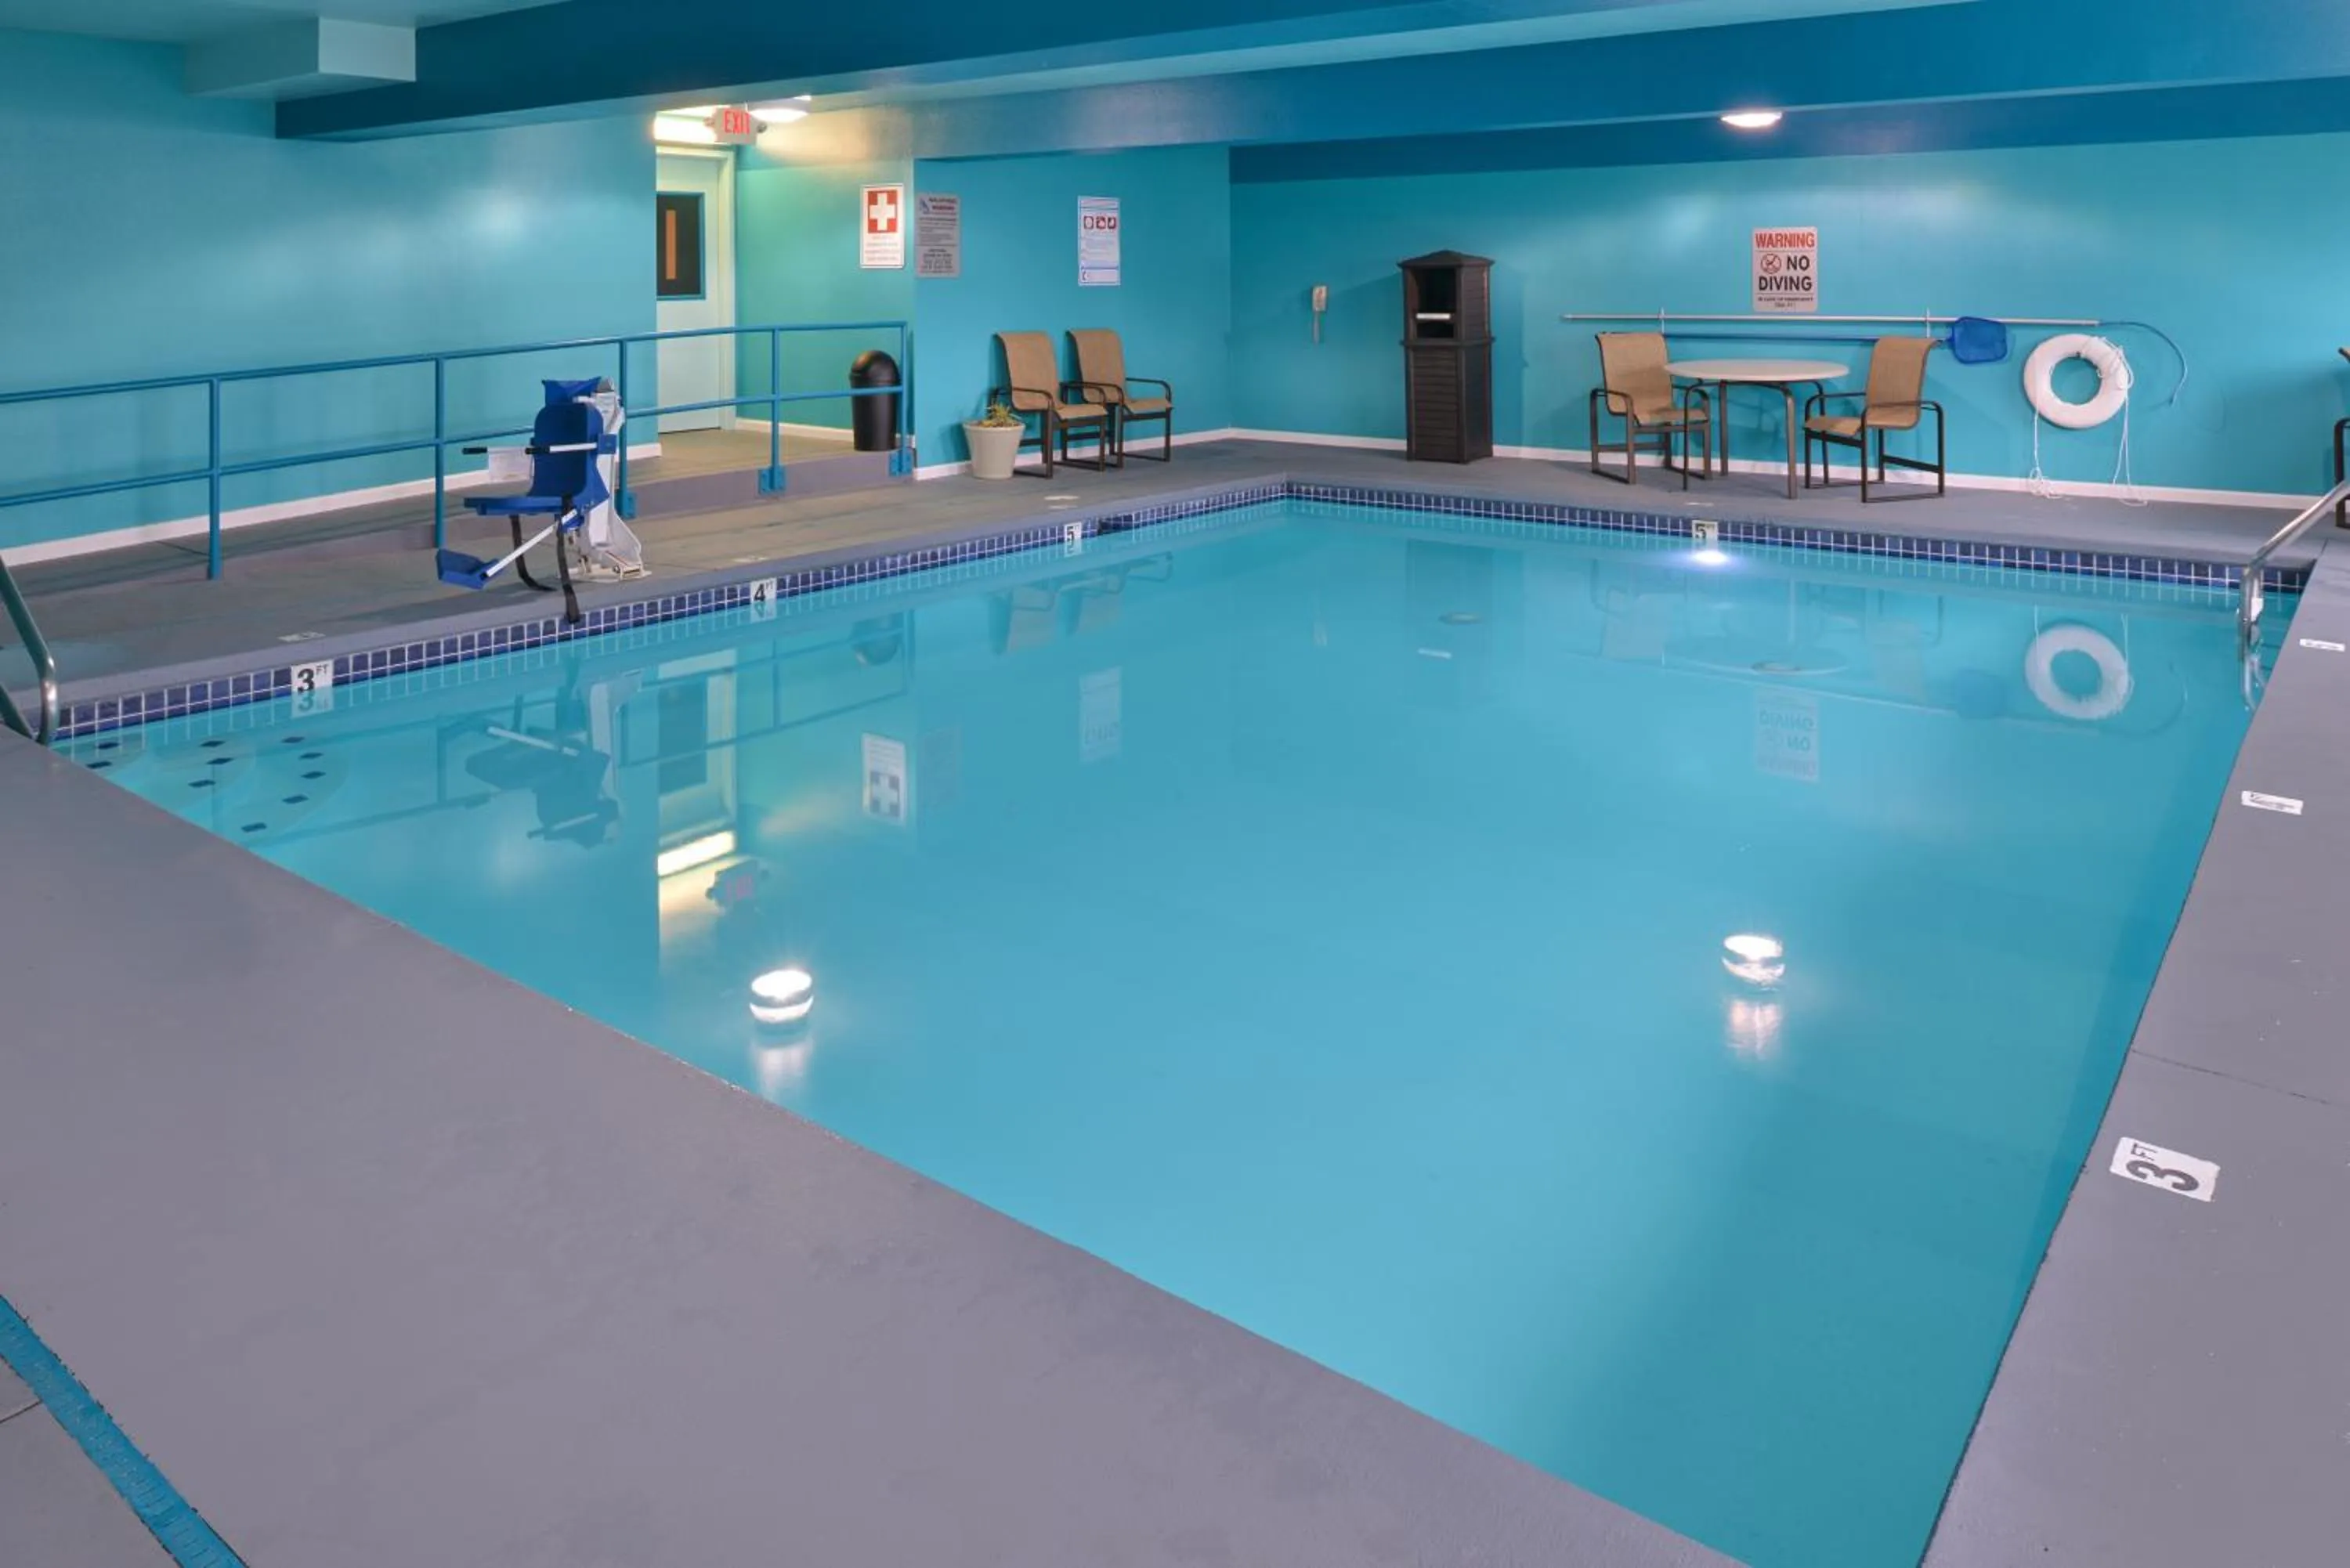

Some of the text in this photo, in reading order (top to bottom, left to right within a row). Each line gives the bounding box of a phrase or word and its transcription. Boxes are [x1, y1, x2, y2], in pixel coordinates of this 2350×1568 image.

[724, 110, 750, 135] EXIT
[1755, 232, 1815, 248] WARNING
[1787, 255, 1810, 271] NO
[1759, 276, 1812, 291] DIVING
[754, 583, 766, 602] 4
[297, 663, 330, 694] 3 FT
[2126, 1142, 2199, 1191] 3 FT
